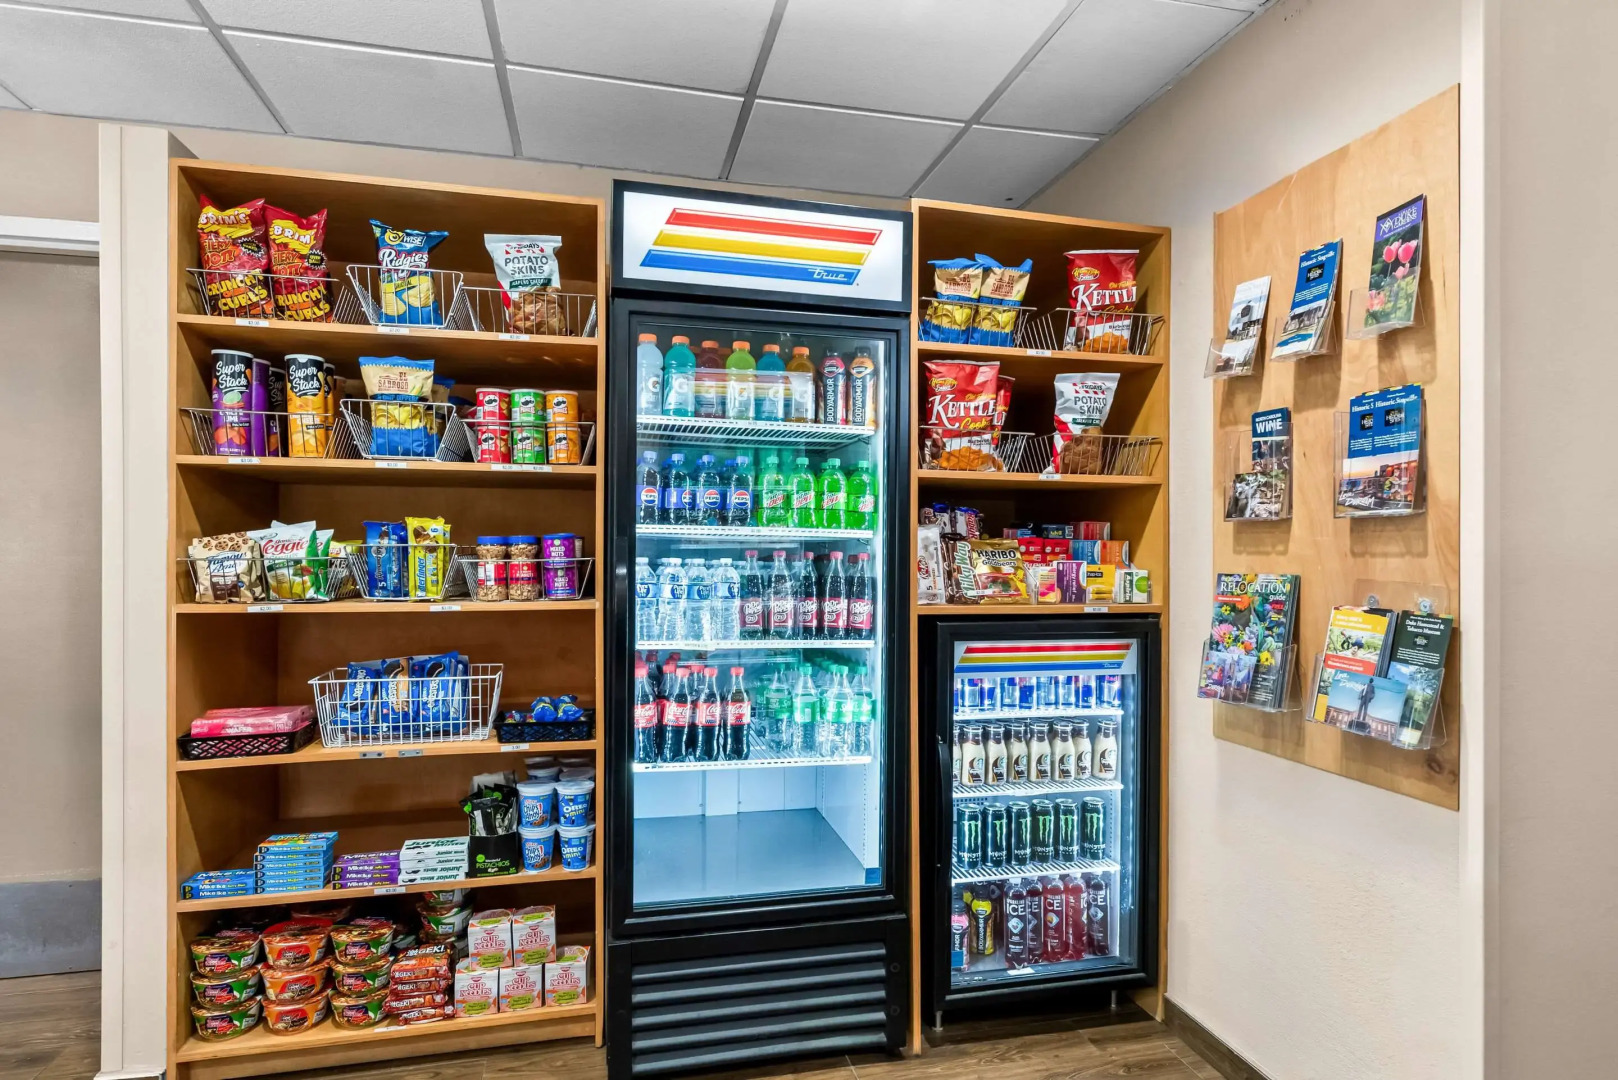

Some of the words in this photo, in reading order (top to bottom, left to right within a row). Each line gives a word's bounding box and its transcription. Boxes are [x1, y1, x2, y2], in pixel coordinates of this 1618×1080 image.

[199, 210, 247, 225] BRIM'S
[273, 225, 315, 244] BRIM'
[403, 236, 423, 245] WISE
[203, 239, 231, 251] FIERY
[272, 251, 300, 263] FIERY
[379, 248, 429, 278] Ridgies
[505, 255, 549, 266] POTATO
[510, 266, 545, 275] SKINS
[219, 286, 268, 310] CURLS
[275, 283, 328, 306] RUNCHY
[285, 301, 331, 322] CURLS
[216, 361, 246, 375] Super
[289, 365, 318, 379] Super
[378, 380, 409, 390] SABROSO
[826, 378, 834, 422] BODYARMOR
[855, 379, 863, 422] BODYARMOR
[1074, 396, 1107, 406] POTATO
[1375, 398, 1395, 407] Historic
[928, 394, 996, 429] KETTLE
[1079, 405, 1104, 415] SKIN
[1352, 404, 1370, 412] Historic
[1256, 418, 1283, 434] WINE
[975, 549, 1016, 559] HARIBO
[1220, 581, 1287, 593] RELOCATION
[563, 804, 588, 813] OREO
[562, 846, 584, 854] OREO
[476, 860, 510, 868] PISTACHIOS
[1007, 904, 1026, 915] ICE
